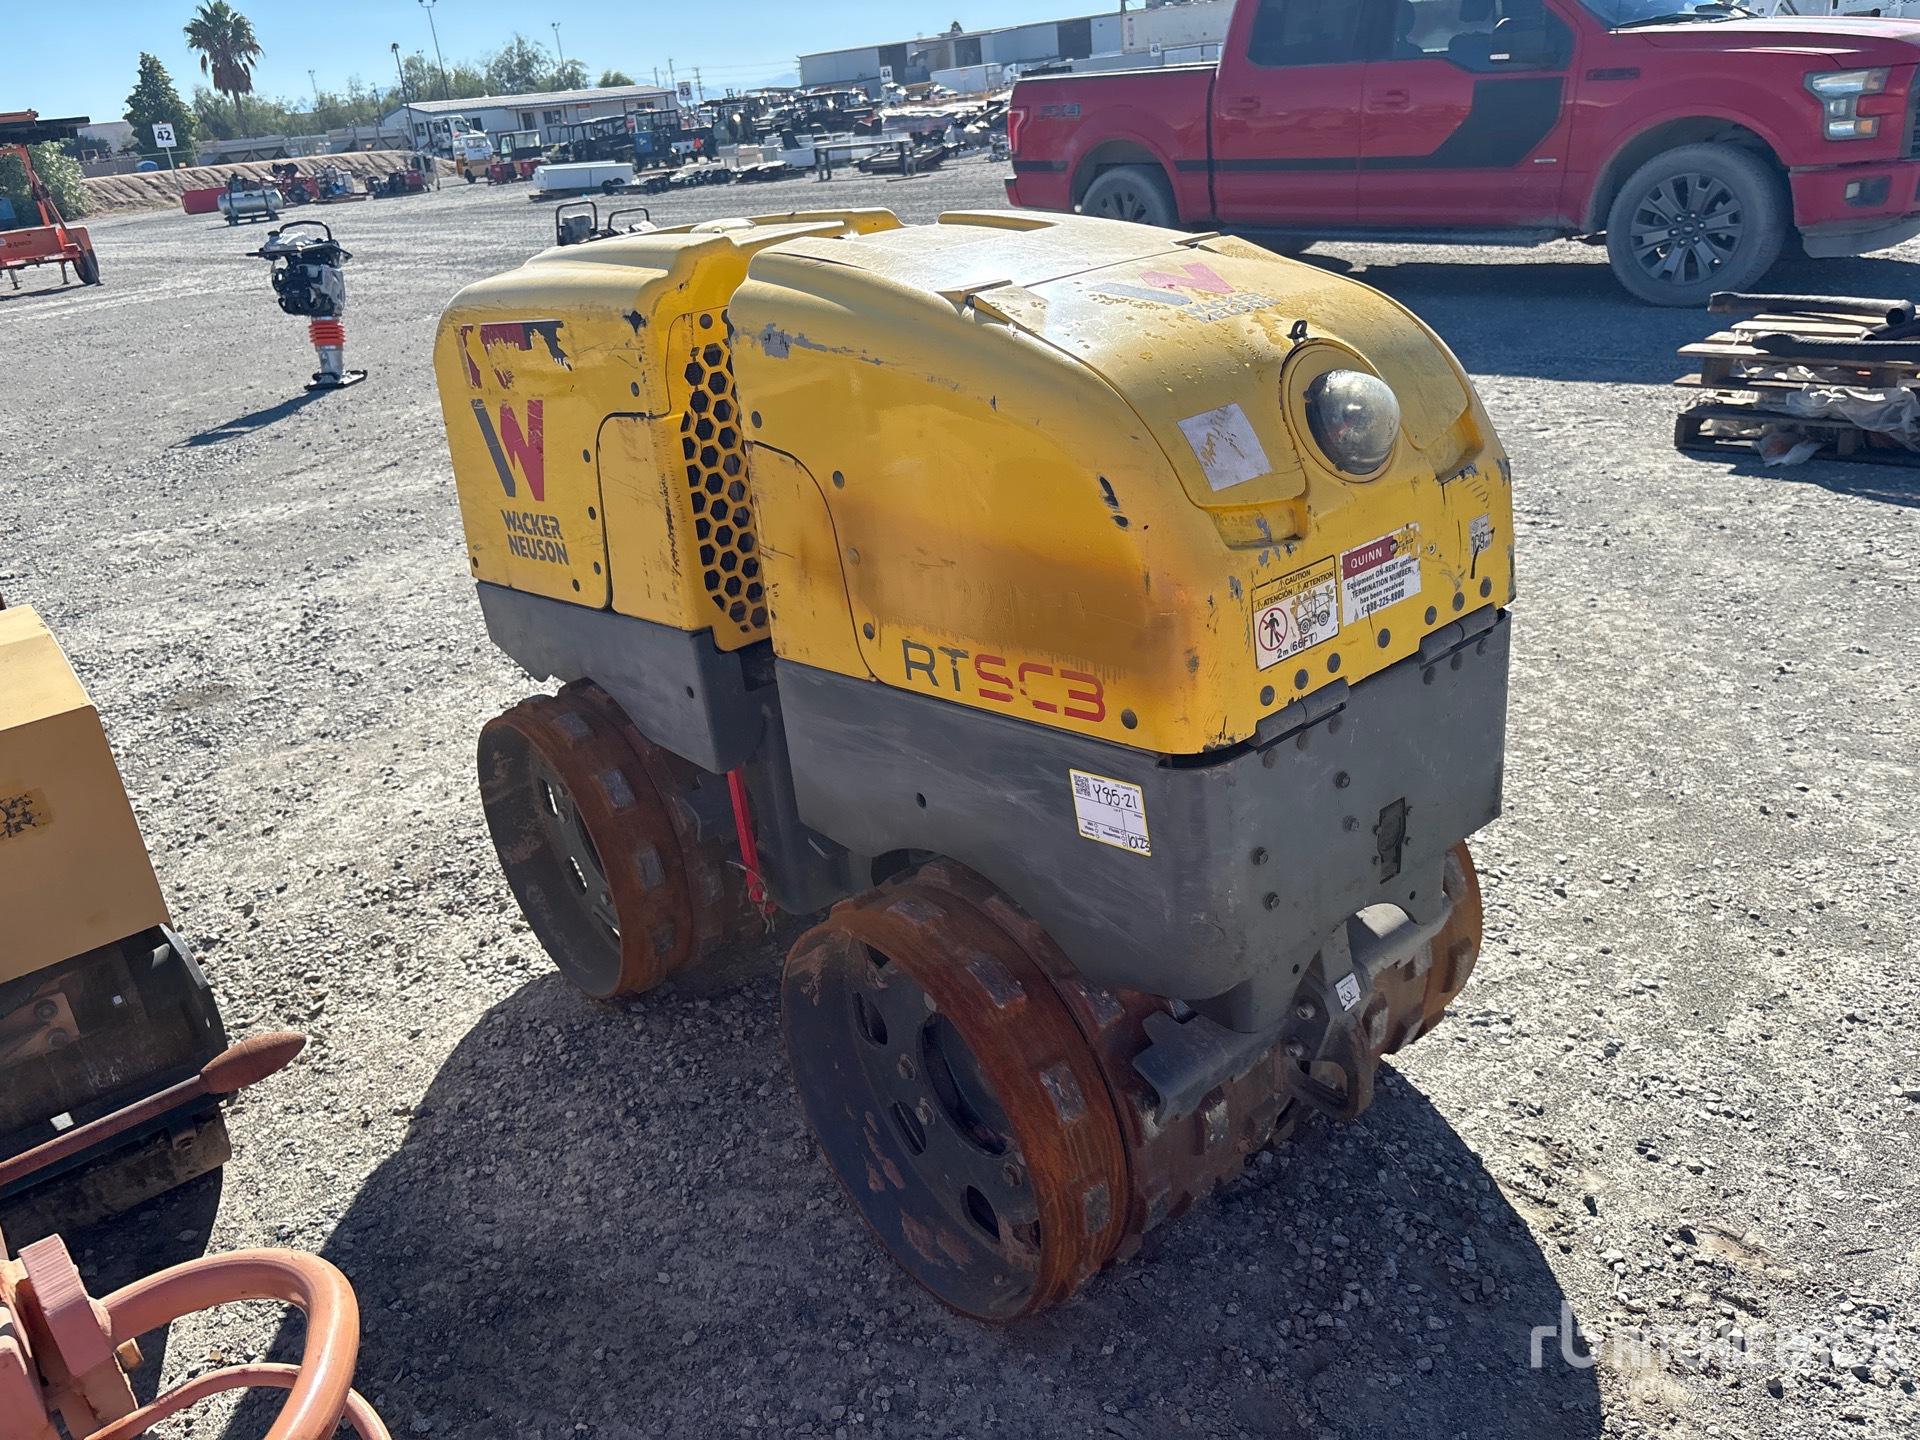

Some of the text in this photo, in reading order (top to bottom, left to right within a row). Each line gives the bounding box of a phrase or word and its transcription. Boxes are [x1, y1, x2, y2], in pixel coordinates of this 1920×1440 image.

[680, 87, 690, 97] 43
[157, 130, 172, 142] 42
[500, 509, 564, 541] WACKER
[507, 534, 570, 566] NEUSON
[1350, 547, 1383, 569] QUINN
[1285, 569, 1311, 586] CAUTION
[1302, 570, 1334, 590] ATTENTION
[1347, 573, 1375, 591] Equipment
[1375, 561, 1399, 578] ON-RENT
[1351, 566, 1412, 599] TERMINATION NUMBER
[1360, 580, 1405, 604] has been received
